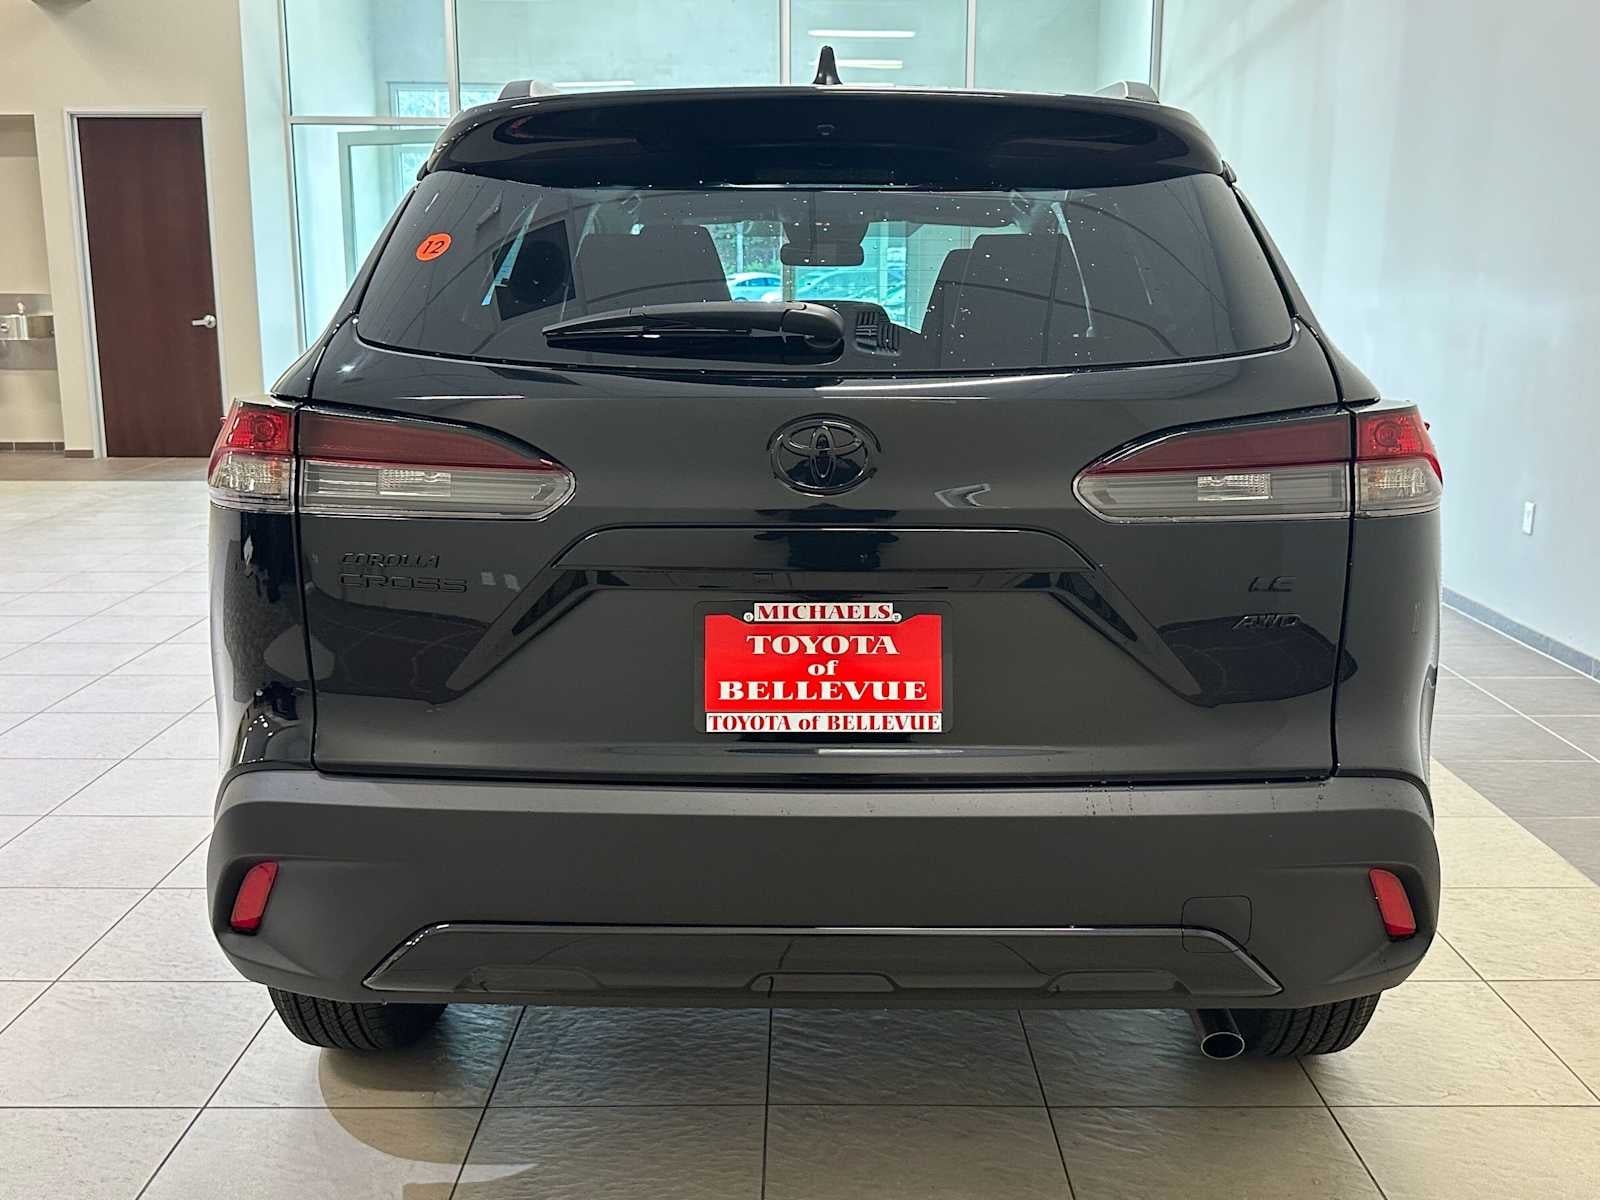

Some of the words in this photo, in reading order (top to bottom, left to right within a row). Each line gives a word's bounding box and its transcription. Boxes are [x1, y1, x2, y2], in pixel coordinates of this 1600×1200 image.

[422, 240, 445, 255] 12
[341, 552, 440, 568] COROLLA
[338, 573, 467, 592] CROSS
[1248, 575, 1297, 592] LE
[757, 604, 891, 620] MICHAELS
[1231, 613, 1301, 631] AWD
[746, 635, 900, 655] TOYOTA
[807, 660, 840, 676] of
[718, 681, 928, 701] BELLEVUE
[708, 715, 791, 731] TOYOTA
[798, 715, 821, 731] of
[827, 715, 941, 731] BELLEVUE
